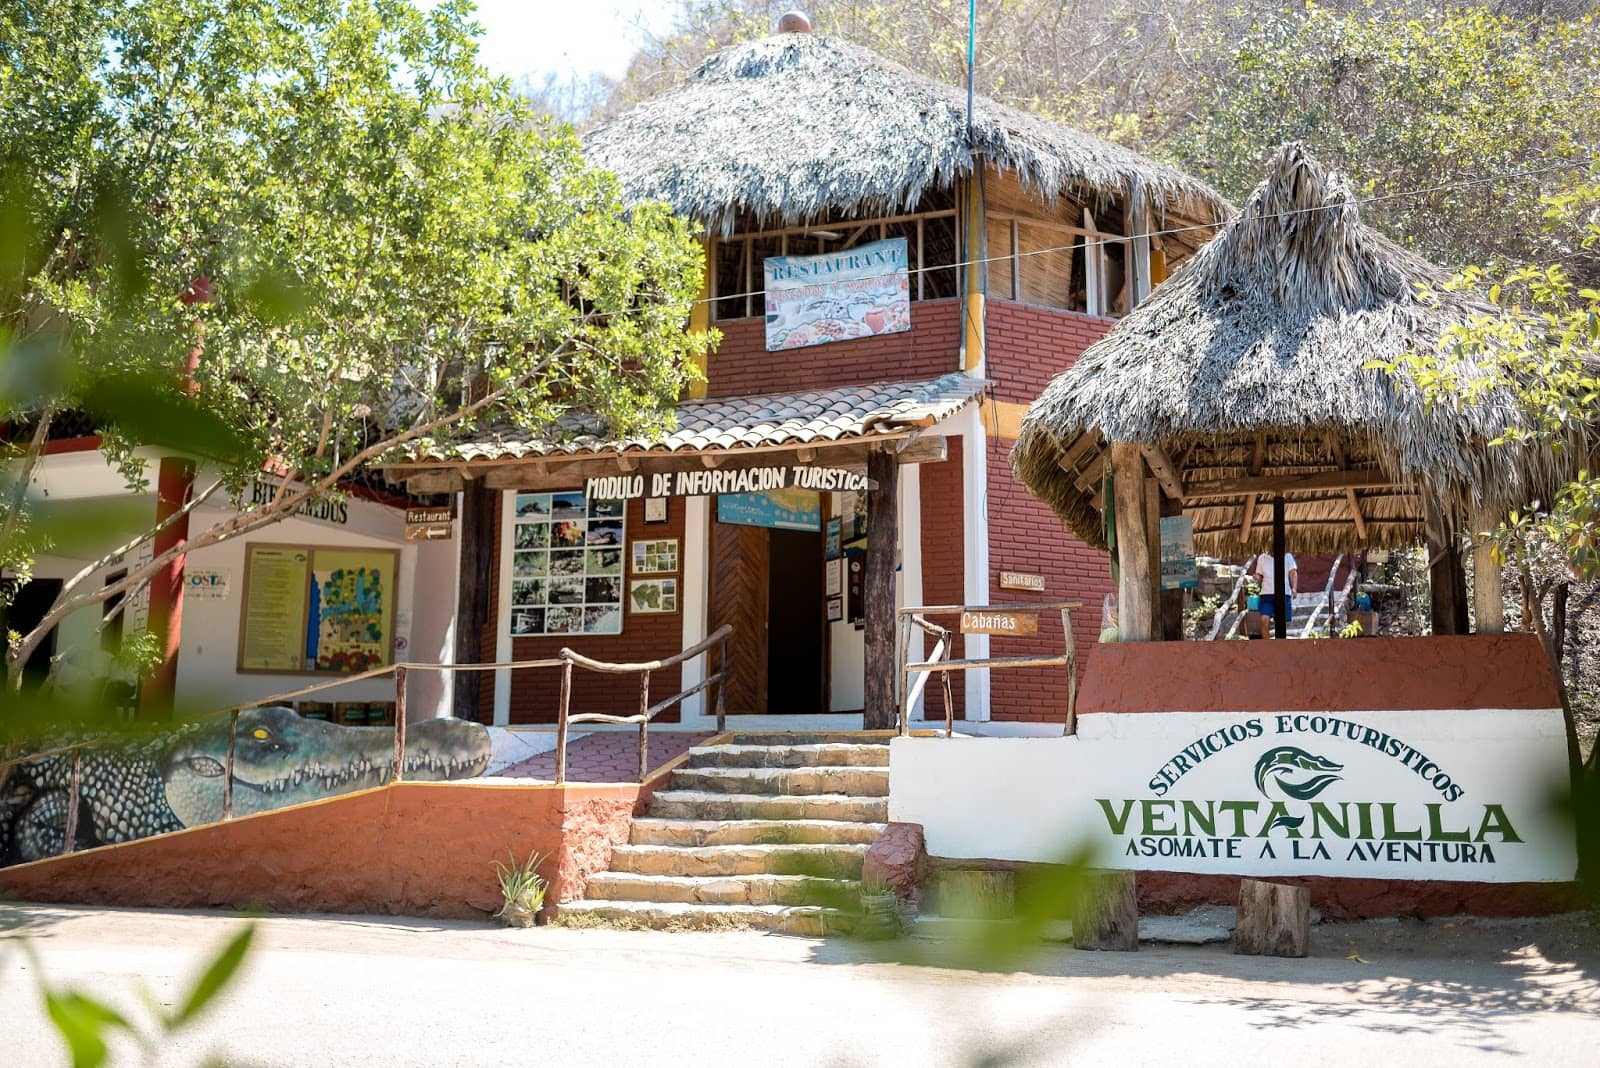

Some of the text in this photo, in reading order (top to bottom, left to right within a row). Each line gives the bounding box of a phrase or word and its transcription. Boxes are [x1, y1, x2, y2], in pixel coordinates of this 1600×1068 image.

[774, 249, 900, 281] RESTAURANT
[586, 466, 869, 500] MODULO DE INFORMACION TURISTICA
[408, 510, 451, 522] Restaurant
[1003, 573, 1043, 587] Sanitarios
[962, 611, 1017, 630] Cabañas
[1148, 715, 1465, 802] SERVICIOS ECOTURISTICOS
[1094, 798, 1526, 843] VENTANILLA
[1126, 836, 1496, 864] ASOMATE A LA AVENTURA
